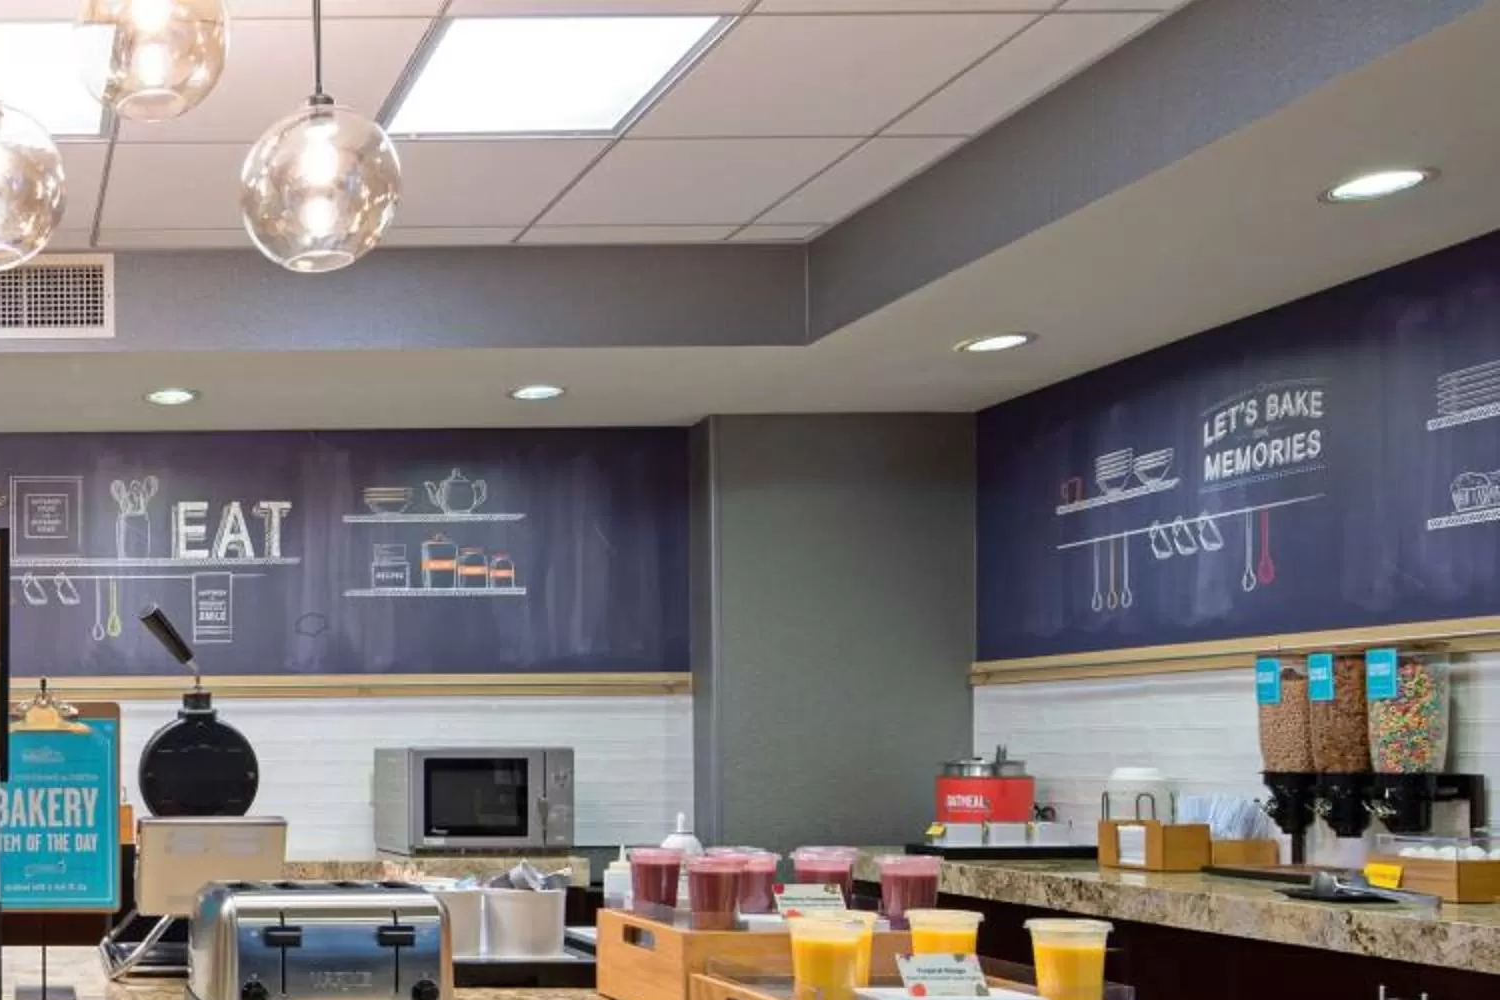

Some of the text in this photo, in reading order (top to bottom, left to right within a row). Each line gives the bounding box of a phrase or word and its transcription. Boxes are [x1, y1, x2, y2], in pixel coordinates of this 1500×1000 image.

[1203, 390, 1324, 448] LET'S BAKE
[1203, 429, 1321, 481] MEMORIES
[172, 501, 292, 559] EAT
[26, 833, 42, 852] OF
[47, 833, 70, 852] THE
[75, 833, 98, 852] DAY
